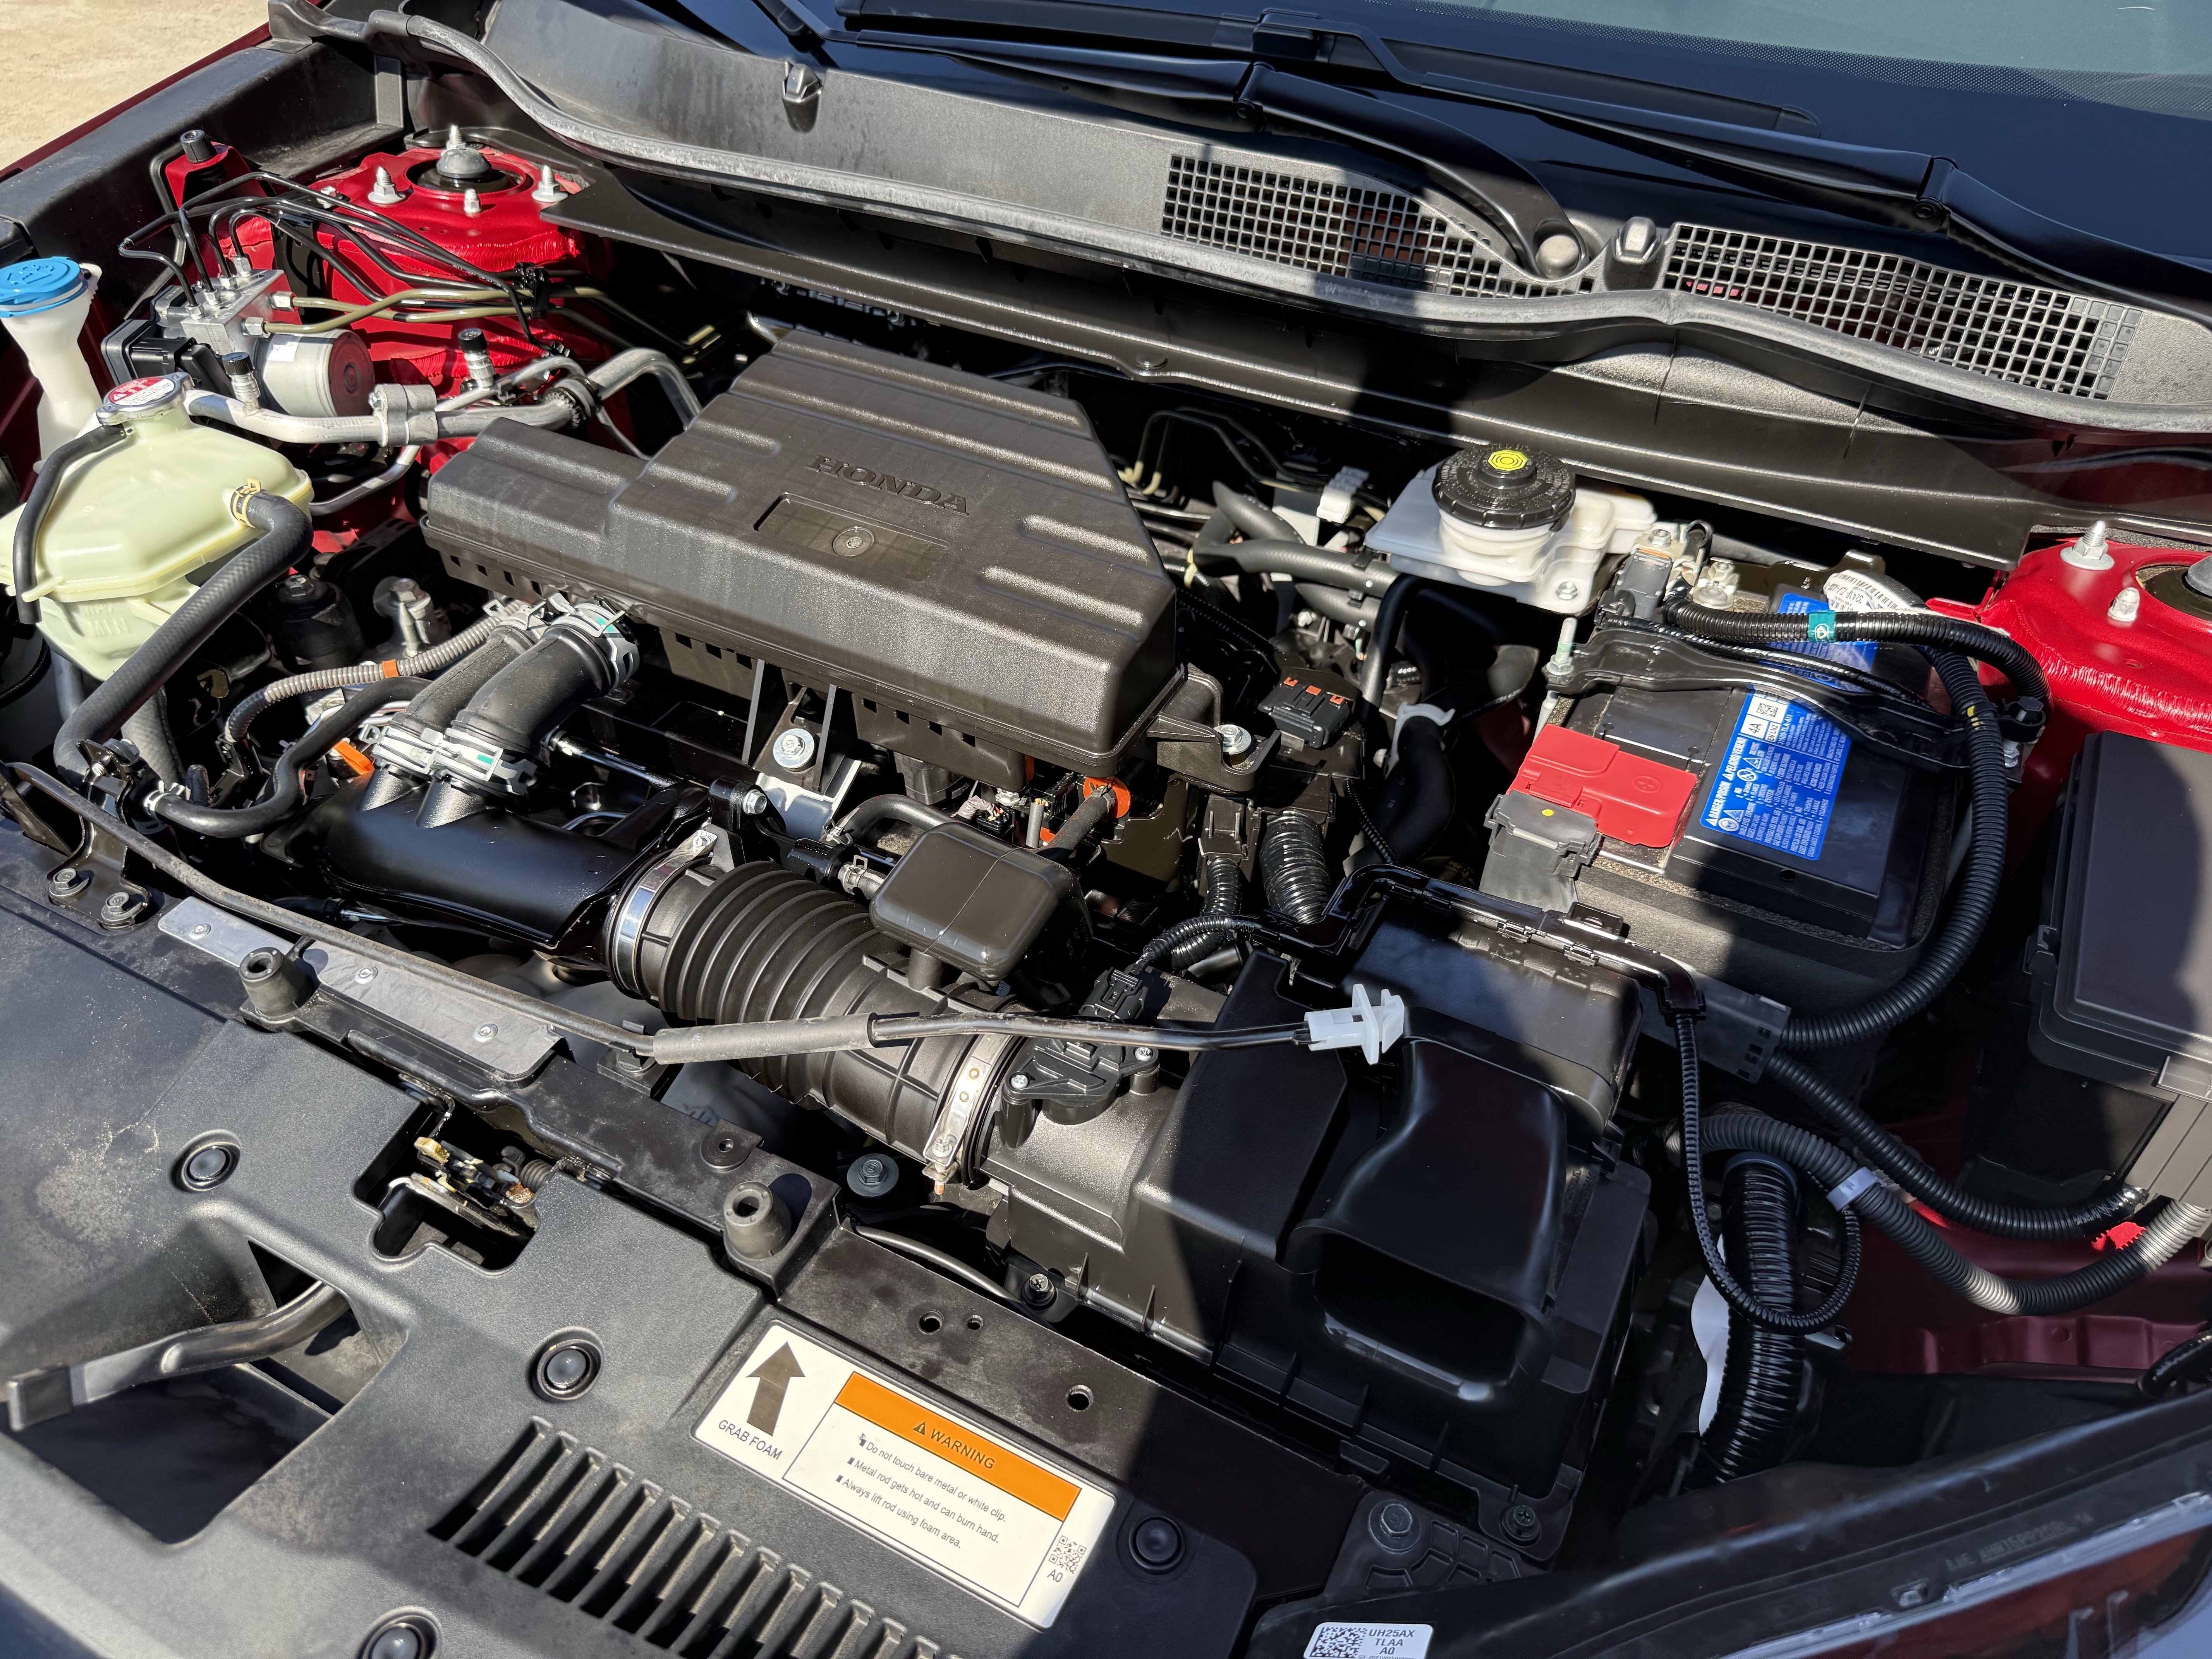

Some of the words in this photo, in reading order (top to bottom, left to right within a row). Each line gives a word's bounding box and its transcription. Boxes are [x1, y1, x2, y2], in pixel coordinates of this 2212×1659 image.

[805, 454, 969, 517] HONDA
[94, 617, 131, 636] MIN
[1748, 723, 1761, 733] 4A
[1769, 725, 1778, 734] LN2
[718, 1420, 750, 1442] GRAB
[749, 1436, 783, 1460] FOAM
[930, 1428, 995, 1469] WARNING
[866, 1442, 878, 1453] Do
[878, 1450, 893, 1462] not
[892, 1456, 914, 1473] touch
[915, 1467, 933, 1482] bare
[934, 1478, 958, 1495] metal
[958, 1491, 968, 1500] or
[968, 1496, 989, 1512] white
[990, 1508, 1006, 1522] clip.
[854, 1460, 878, 1477] Metal
[876, 1473, 892, 1484] rod
[890, 1480, 909, 1494] gets
[908, 1488, 924, 1502] hot
[923, 1498, 941, 1510] and
[940, 1507, 956, 1519] can
[956, 1513, 975, 1530] burn
[976, 1524, 999, 1543] hand.
[842, 1479, 871, 1498] Always
[871, 1493, 883, 1505] lift
[881, 1500, 898, 1512] rod
[896, 1508, 919, 1526] using
[919, 1518, 940, 1536] foam
[941, 1532, 961, 1549] area.
[1046, 1569, 1063, 1583] A0
[1368, 1629, 1416, 1637] UH25AX
[1375, 1638, 1403, 1646] TLAA
[1379, 1647, 1395, 1655] A0
